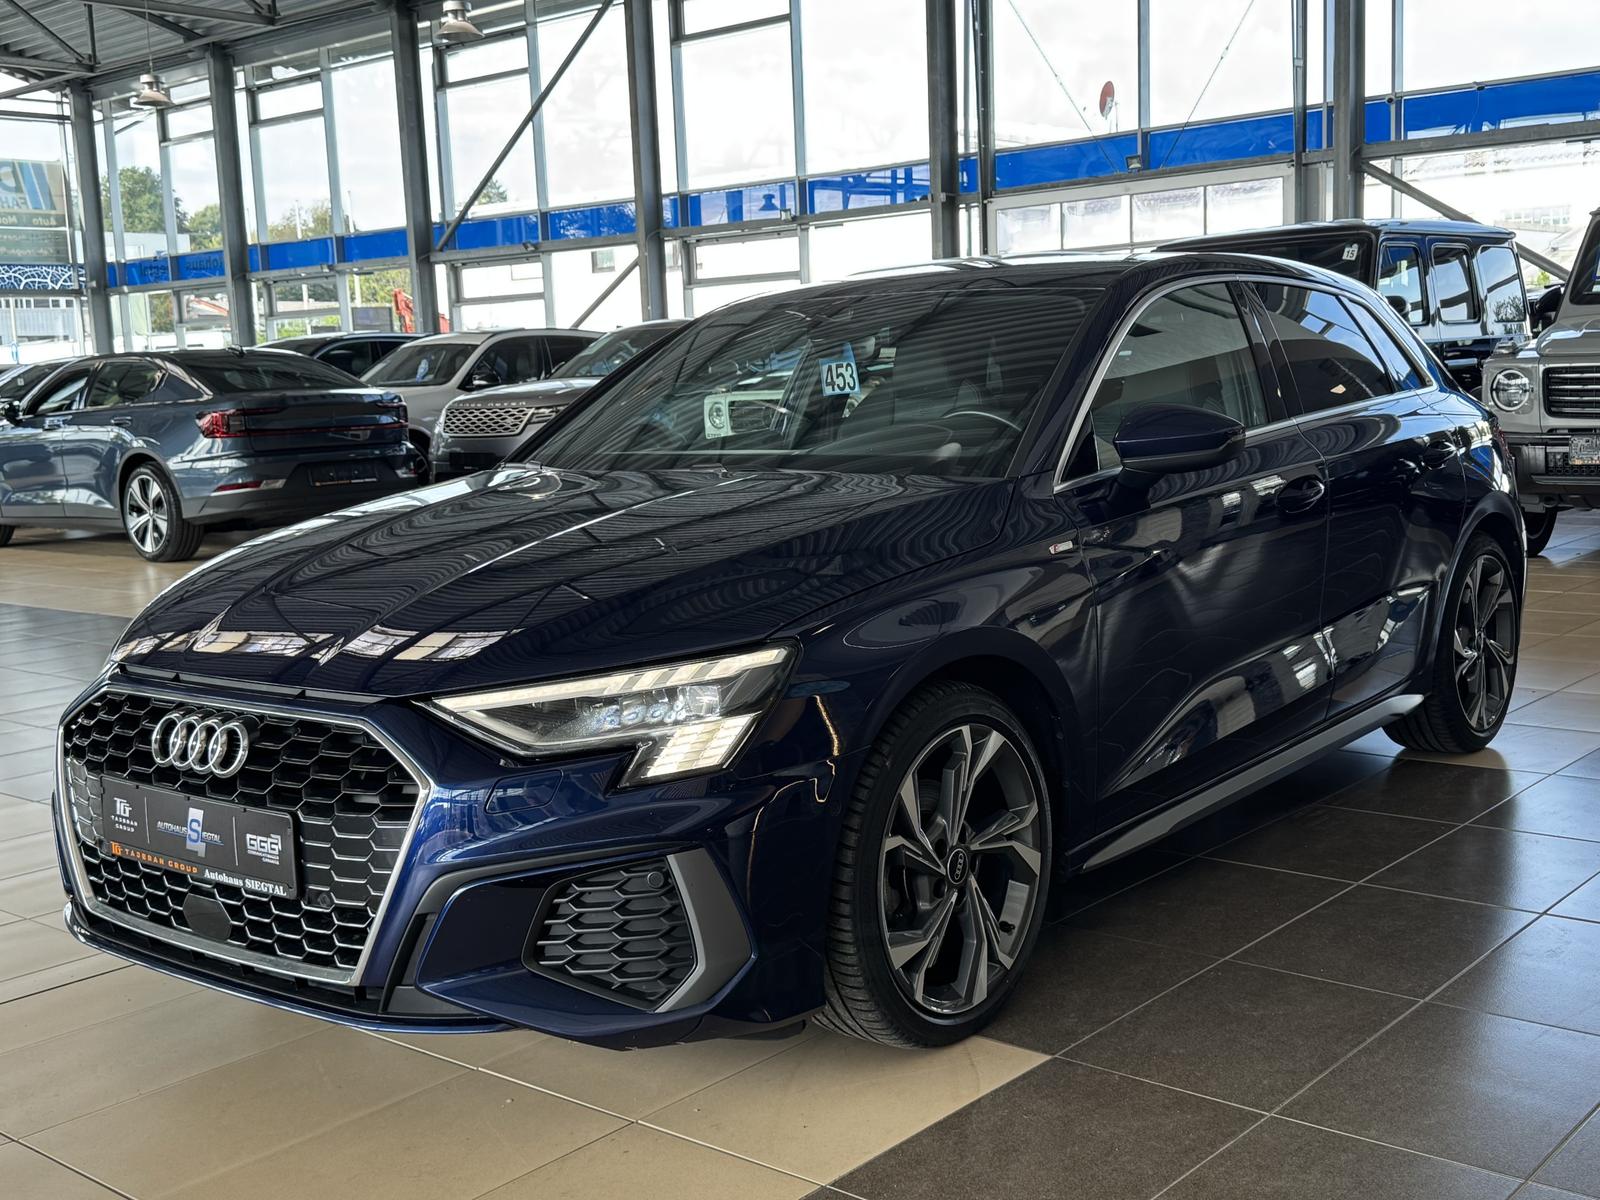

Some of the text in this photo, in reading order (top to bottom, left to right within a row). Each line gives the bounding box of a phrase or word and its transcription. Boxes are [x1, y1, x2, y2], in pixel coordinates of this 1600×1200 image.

[825, 362, 856, 392] 453
[156, 820, 188, 835] AUTOHAUS
[246, 833, 281, 855] GGG
[204, 868, 287, 896] Autohaus SIEGTAL
